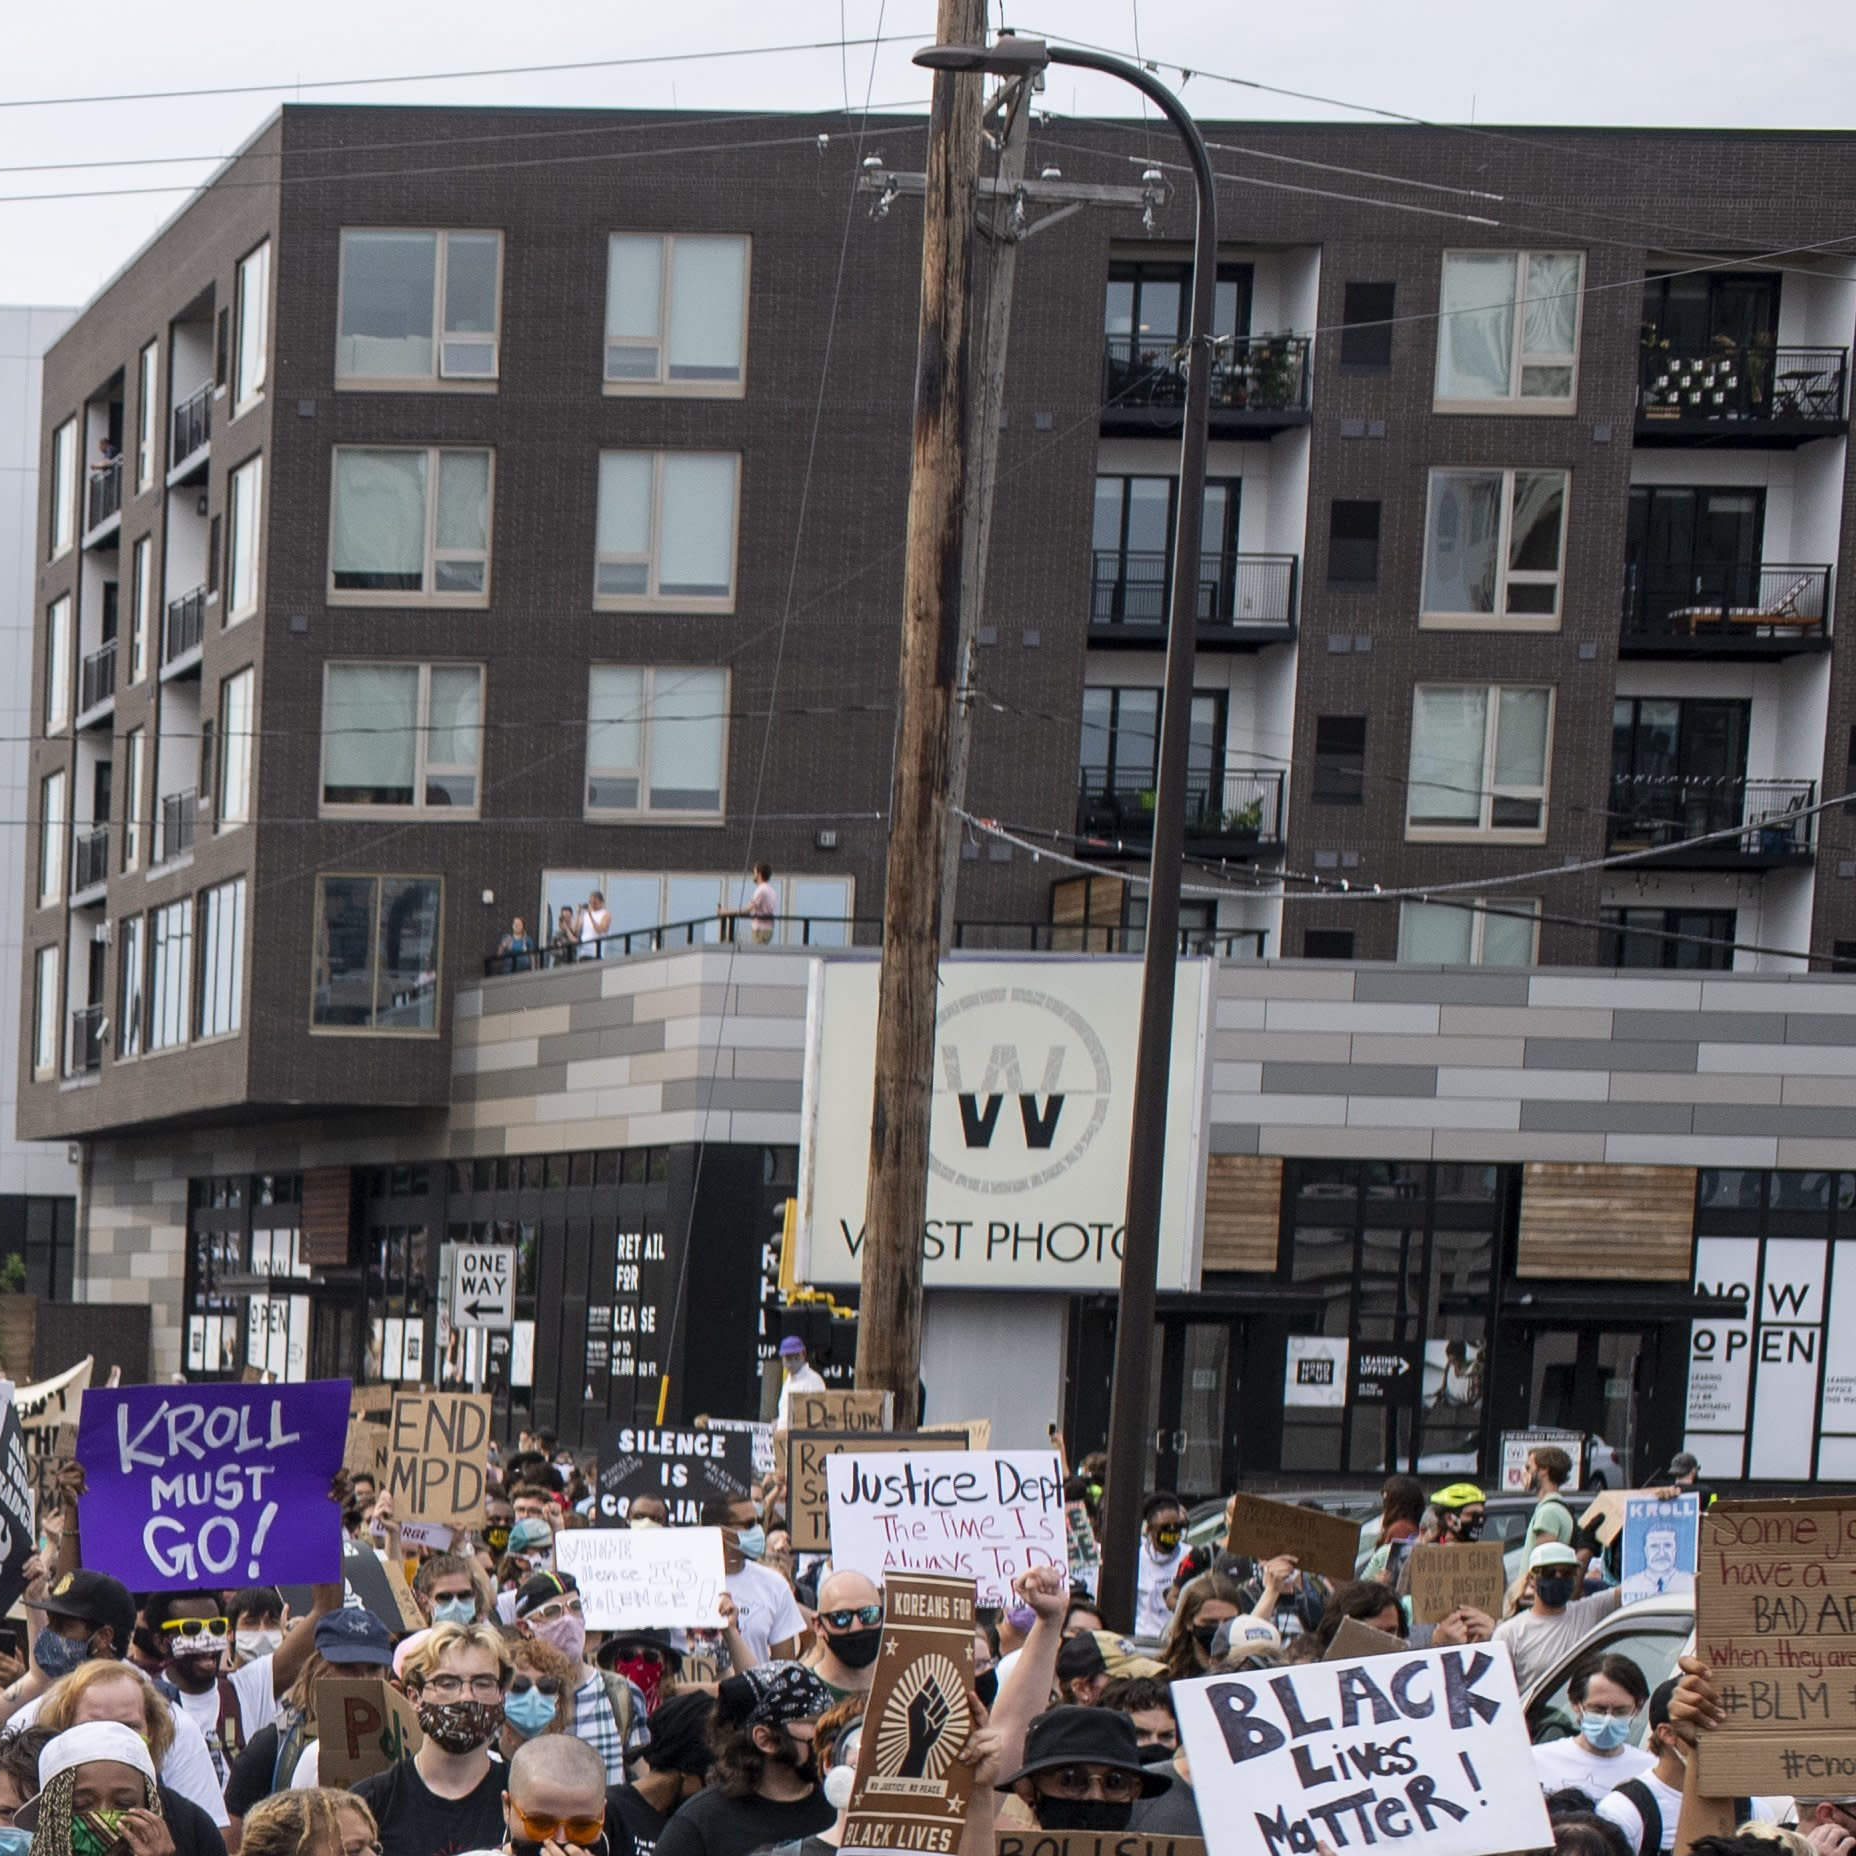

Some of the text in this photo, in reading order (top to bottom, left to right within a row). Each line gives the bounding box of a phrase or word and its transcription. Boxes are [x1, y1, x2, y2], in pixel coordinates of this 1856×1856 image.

[464, 1254, 507, 1273] ONE
[616, 1265, 639, 1292] FOR
[461, 1276, 507, 1296] WAY
[249, 1301, 287, 1334] OPEN
[1360, 1355, 1398, 1367] LEASING
[1693, 1328, 1815, 1364] OPEN
[117, 1400, 300, 1475] KROLL
[392, 1397, 486, 1454] END
[618, 1428, 727, 1459] SILENCE
[151, 1463, 275, 1512] MUST
[389, 1455, 483, 1514] MPD
[660, 1462, 689, 1488] IS
[840, 1459, 988, 1508] Justice
[993, 1456, 1065, 1513] Dept
[872, 1514, 929, 1544] The
[1007, 1506, 1055, 1541] Is
[1629, 1501, 1695, 1519] KROLL
[1712, 1505, 1818, 1549] Some
[141, 1501, 278, 1581] GO!
[983, 1545, 1016, 1578] To
[1719, 1551, 1829, 1589] have a
[894, 1591, 950, 1620] KOREANS
[952, 1596, 972, 1621] FOR
[1751, 1594, 1808, 1636] BAD
[1773, 1638, 1825, 1679] they
[1205, 1651, 1503, 1765] BLACK
[1719, 1679, 1831, 1721] #BLM
[869, 1783, 878, 1792] NO
[909, 1784, 918, 1793] NO
[843, 1821, 954, 1853] BLACK LIVES
